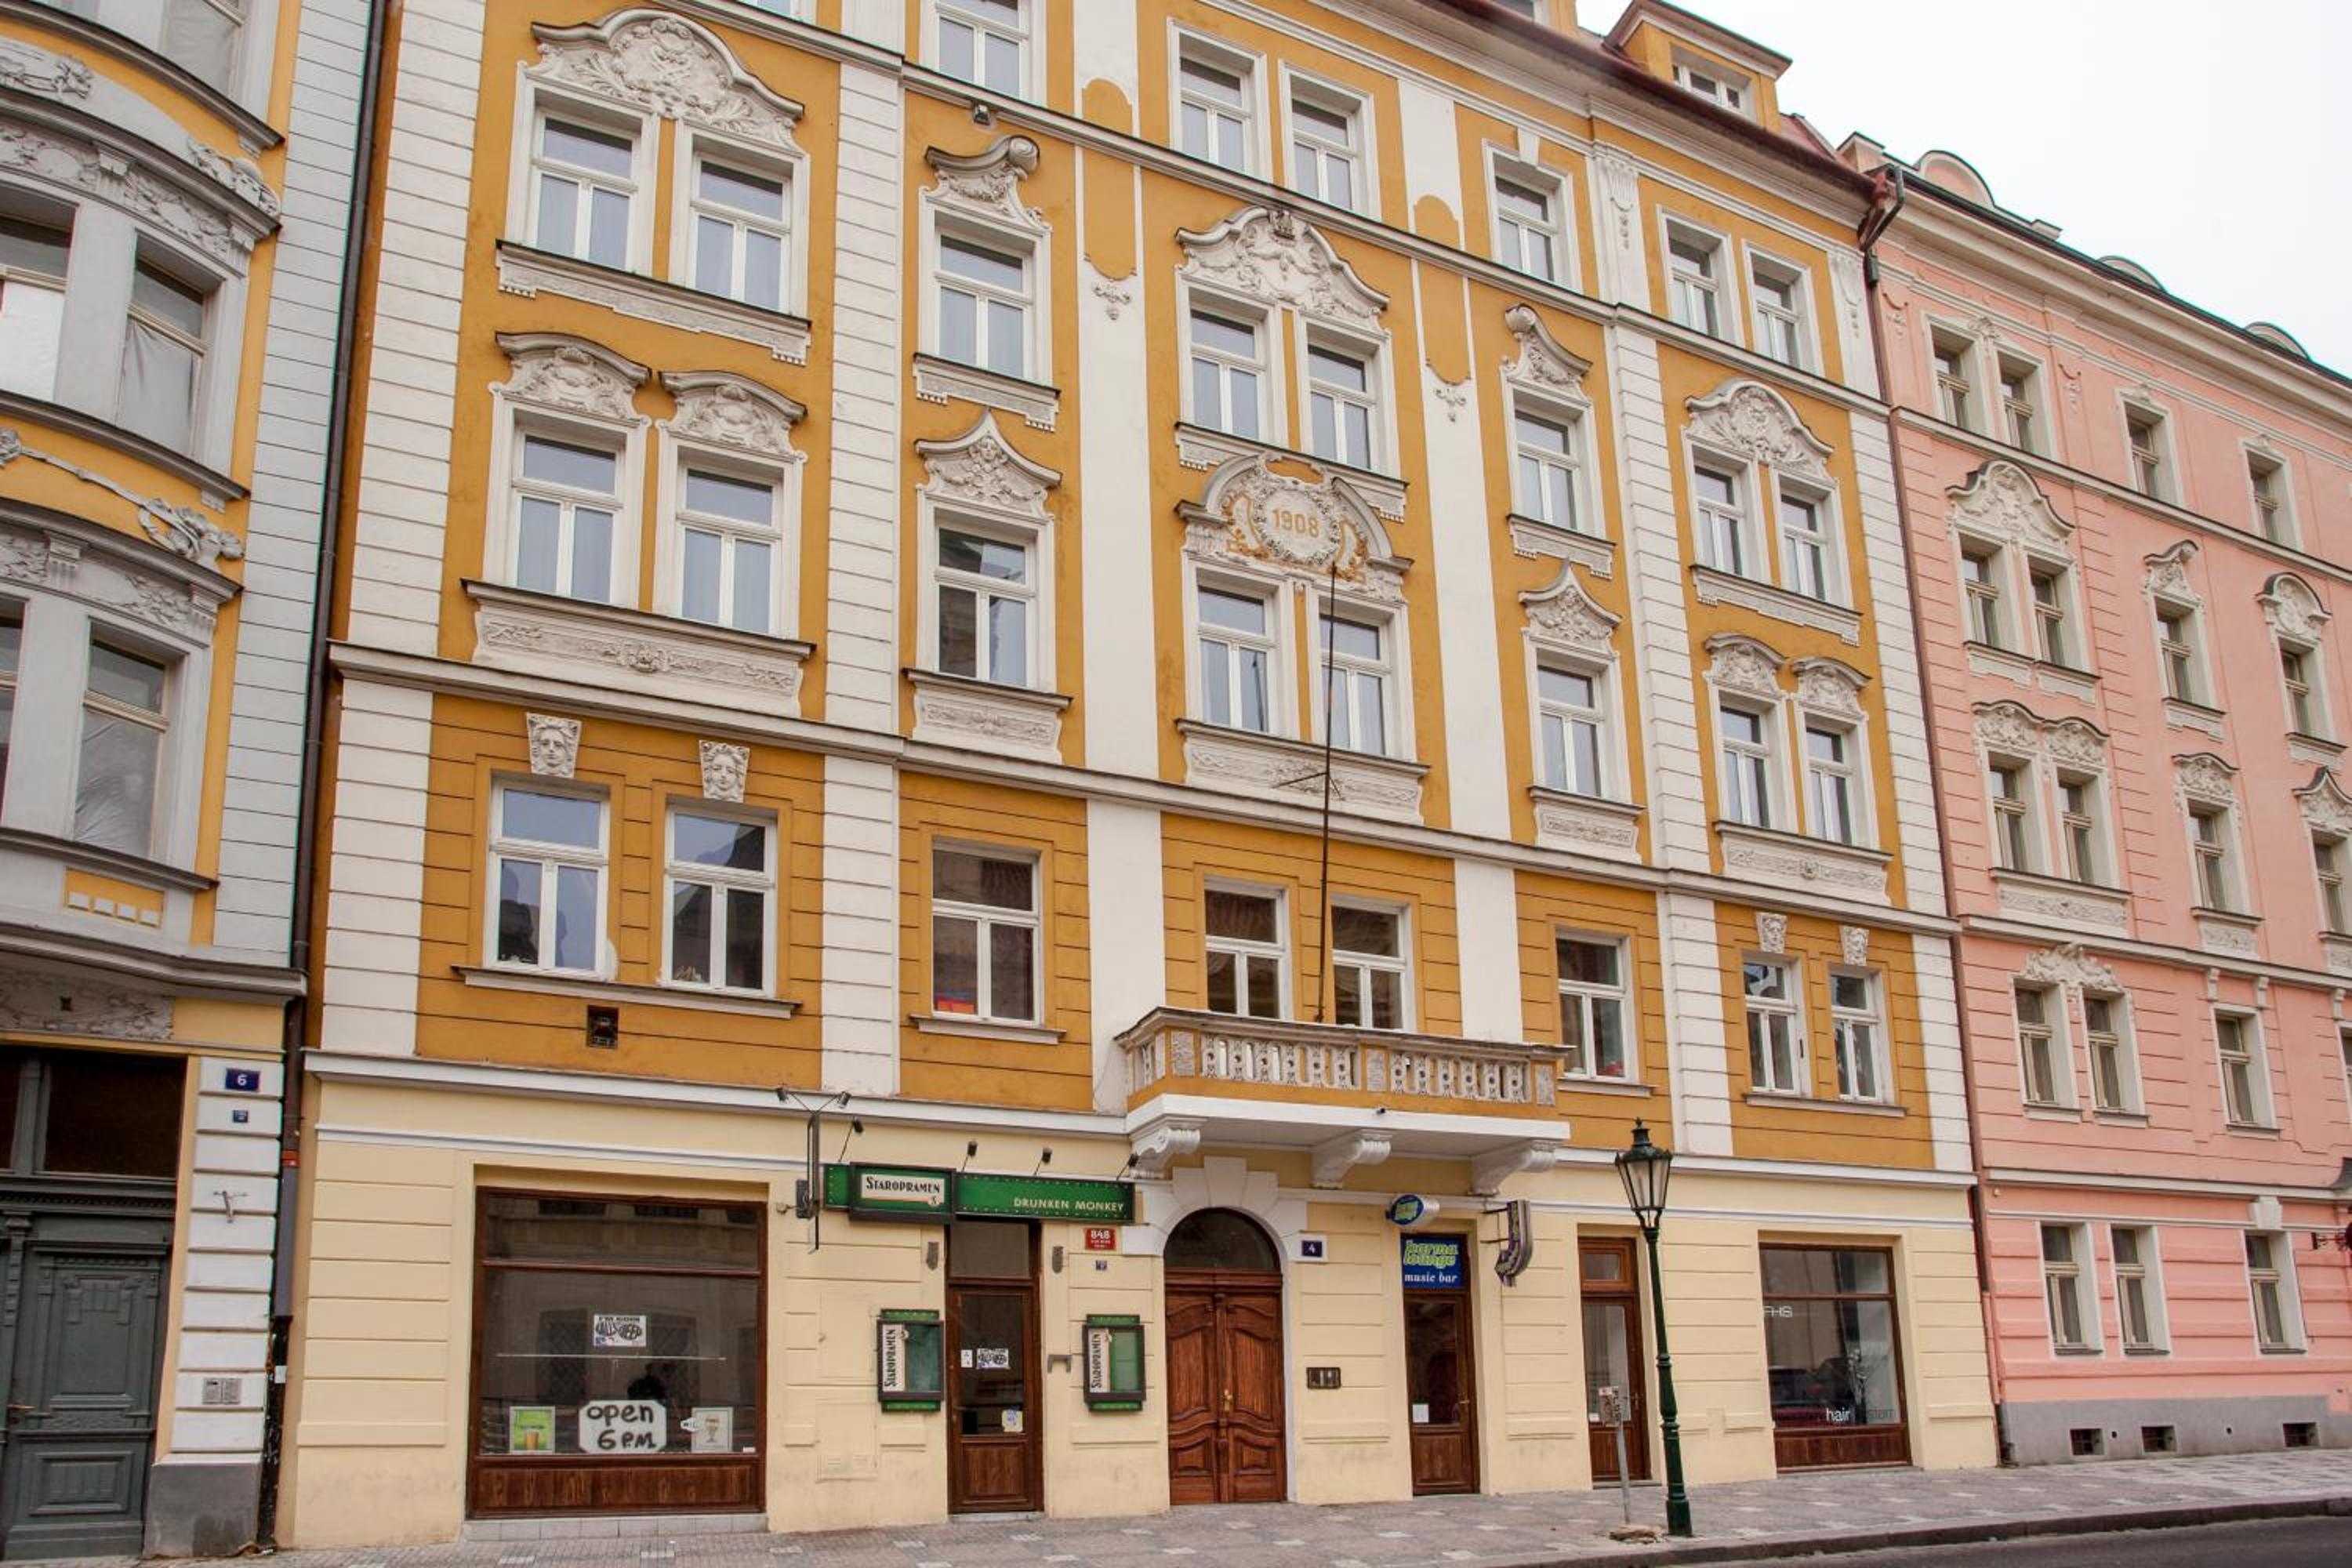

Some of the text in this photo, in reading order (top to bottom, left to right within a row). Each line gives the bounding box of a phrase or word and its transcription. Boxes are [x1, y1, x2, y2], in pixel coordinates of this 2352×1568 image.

[1271, 506, 1320, 539] 1908
[238, 1074, 248, 1087] 6
[866, 1175, 941, 1194] STAROPRAMEN
[1014, 1197, 1124, 1212] DRUNKEN MONKEY
[1308, 1243, 1316, 1254] 4
[1403, 1254, 1457, 1269] lounge
[1404, 1272, 1458, 1283] music bar
[884, 1329, 897, 1387] STAROPRAMEN
[1091, 1334, 1102, 1388] STAROPRAMEN
[587, 1404, 654, 1427] open
[1825, 1407, 1851, 1422] hair
[597, 1429, 617, 1450] 6
